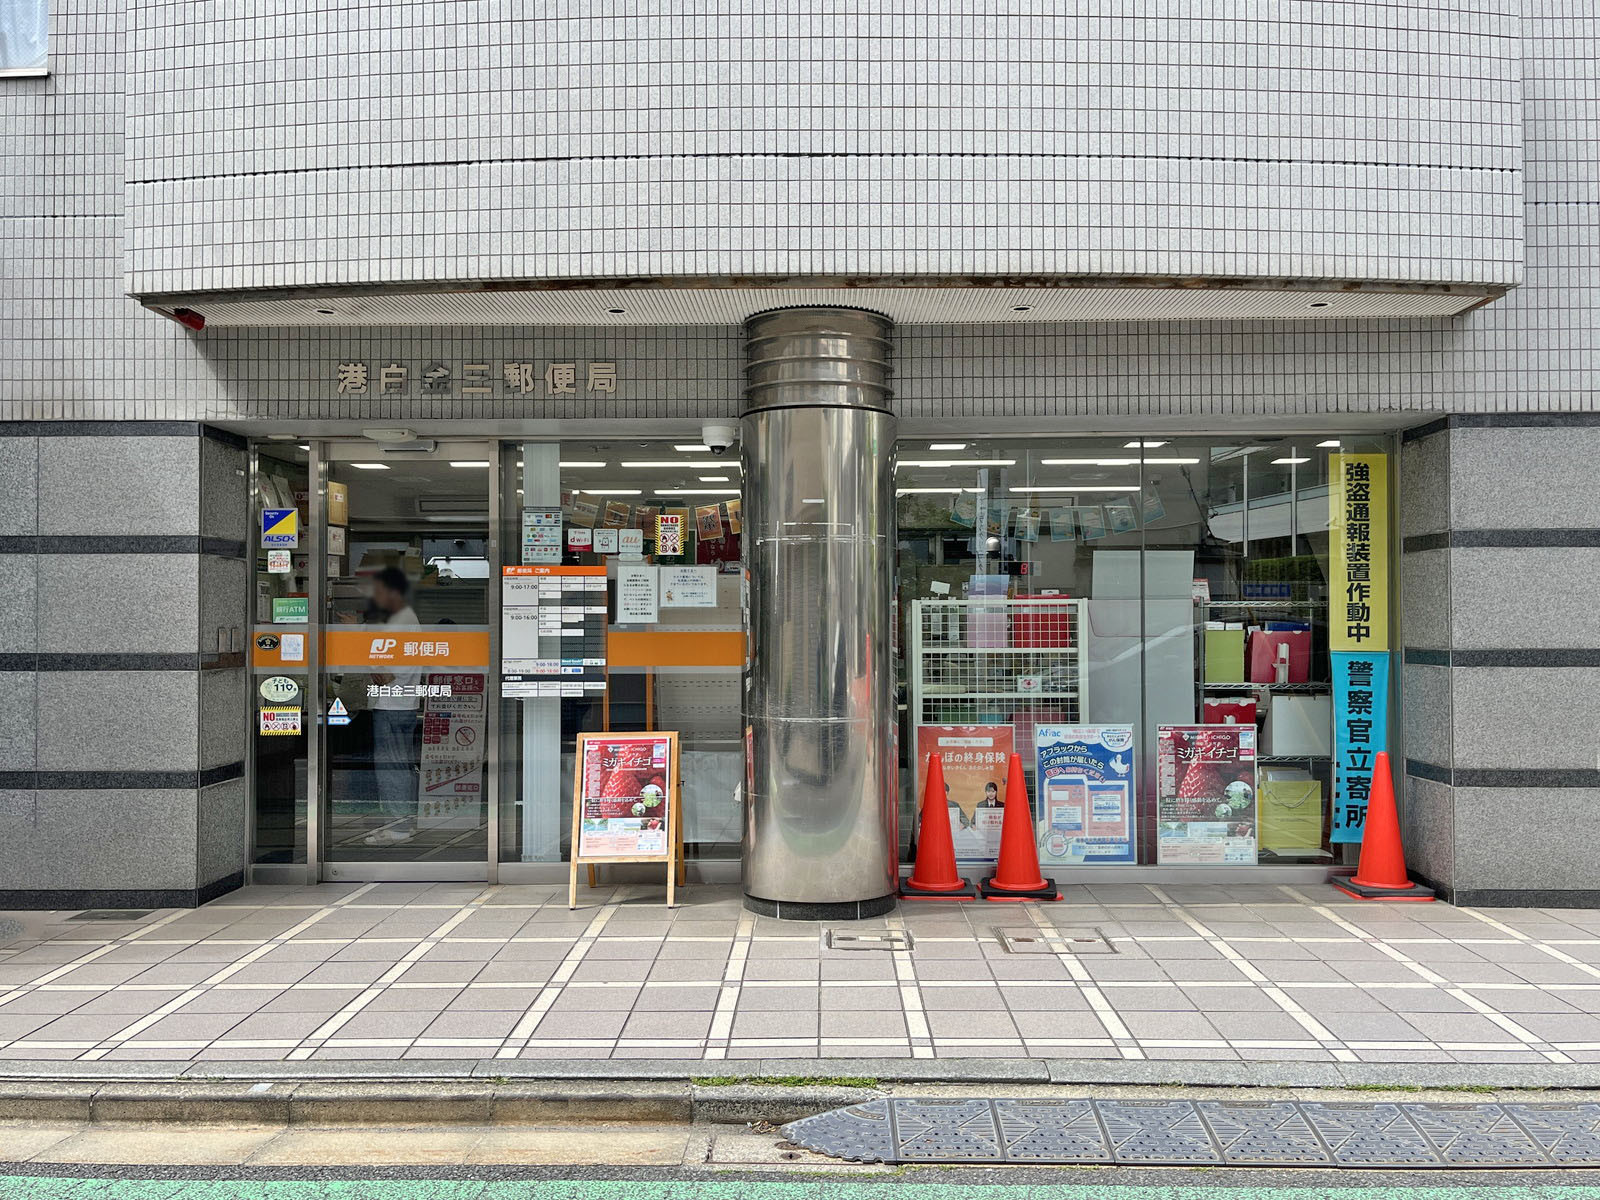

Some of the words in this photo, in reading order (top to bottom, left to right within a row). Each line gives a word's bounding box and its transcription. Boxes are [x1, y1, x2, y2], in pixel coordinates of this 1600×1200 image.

[337, 362, 617, 395] 港白金三郵便局
[661, 516, 679, 526] NO
[264, 535, 295, 543] ALSOK
[622, 536, 640, 544] au
[1346, 462, 1370, 643] 強盗通報装置作動中
[403, 641, 450, 656] 郵便局
[366, 684, 452, 698] 港白金三郵便局
[263, 713, 275, 721] NO
[1346, 660, 1373, 828] 警察官立寄所
[1040, 745, 1088, 758] アフラックから
[1177, 747, 1238, 759] ミガキイチゴ
[602, 757, 651, 767] ミガキイチゴ
